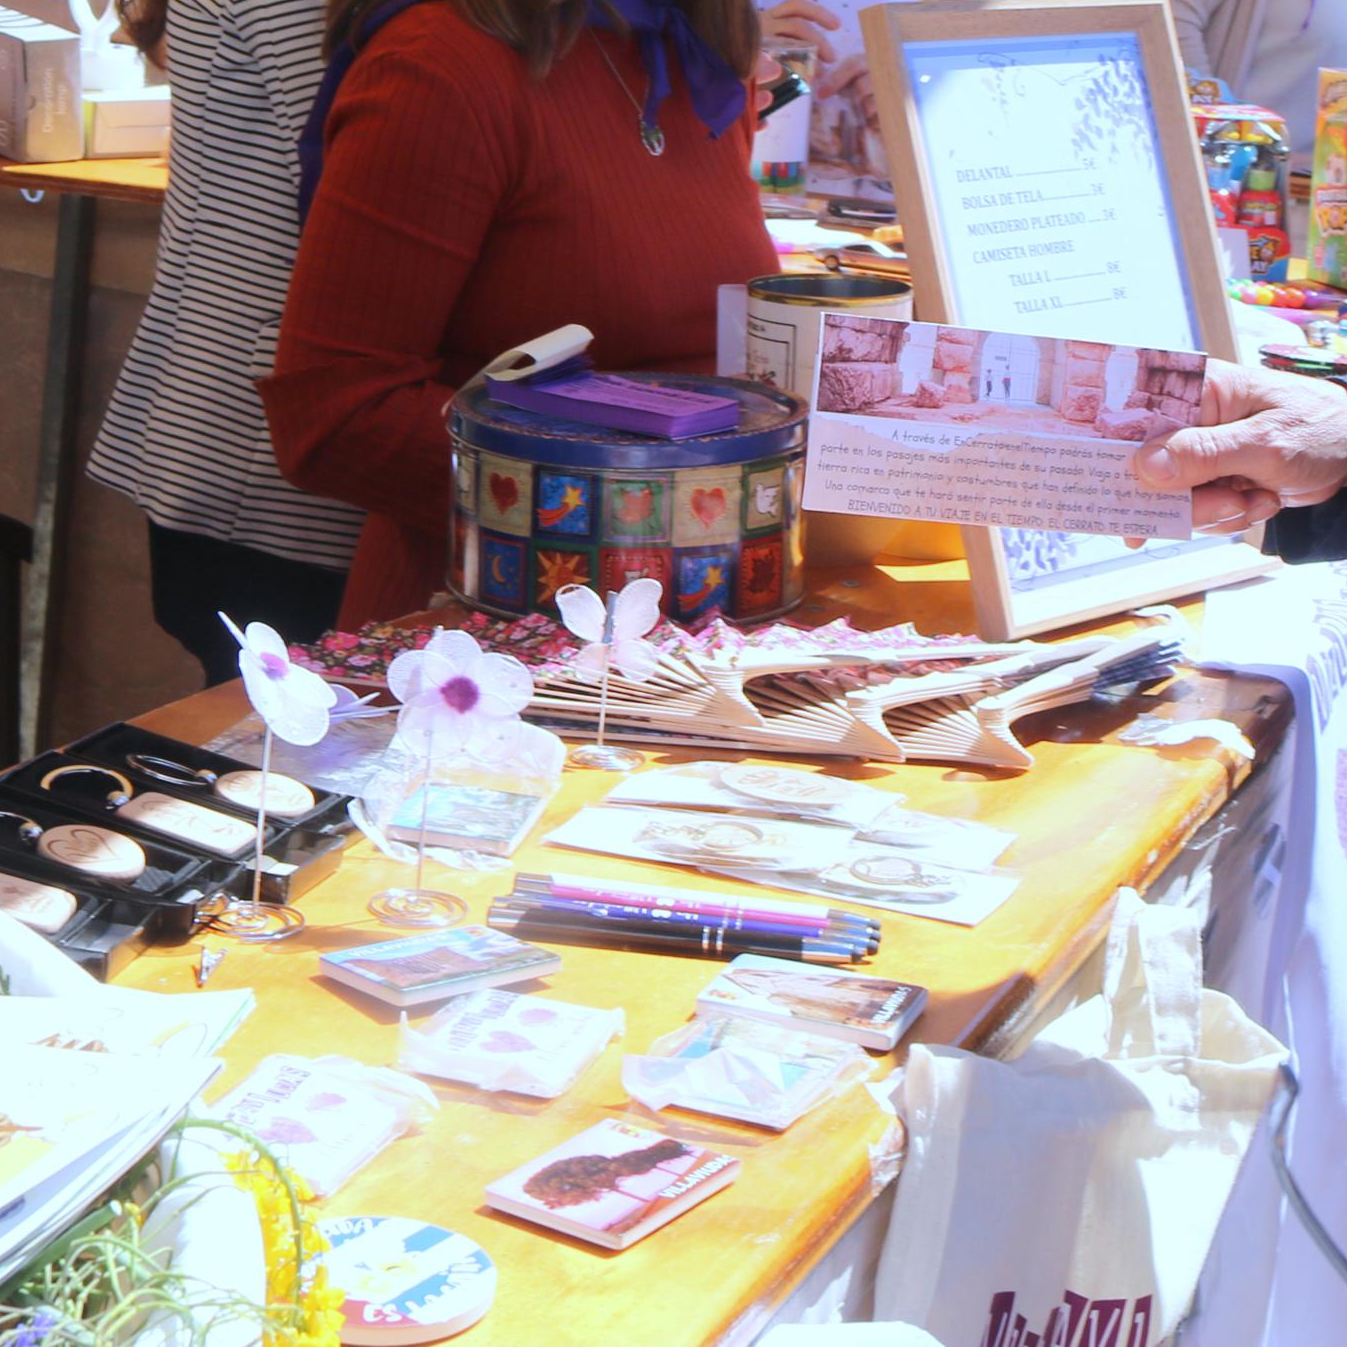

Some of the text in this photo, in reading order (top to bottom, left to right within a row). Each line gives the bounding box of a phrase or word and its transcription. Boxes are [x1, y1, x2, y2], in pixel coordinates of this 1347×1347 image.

[956, 166, 1013, 183] DELANTAL
[962, 194, 998, 210] BOLSA
[1000, 193, 1014, 206] DE
[1015, 190, 1043, 204] TELA
[967, 218, 1030, 236] MONEDERO
[1031, 211, 1086, 230] PLATEADO
[973, 240, 1075, 264] CAMISETA HOMBRE
[1009, 272, 1042, 287] TALLA
[1014, 299, 1047, 314] TALLA
[892, 432, 899, 440] A
[903, 432, 936, 445] través
[939, 434, 951, 445] de
[820, 443, 850, 456] parte
[852, 445, 864, 456] en
[867, 445, 883, 458] los
[886, 448, 925, 465] pasajes
[929, 451, 951, 463] más
[954, 455, 1016, 470] importantes
[1019, 459, 1032, 471] de
[1034, 462, 1047, 472] su
[817, 460, 848, 473] tierra
[851, 462, 871, 475] rica
[873, 466, 885, 477] en
[888, 466, 945, 482] patrimonio
[956, 472, 1019, 490] costumbres
[1021, 480, 1040, 494] que
[1114, 488, 1132, 503] que
[1135, 488, 1153, 503] hoy
[825, 479, 844, 492] Una
[846, 483, 890, 496] comarca
[893, 486, 911, 500] que
[914, 487, 926, 499] te
[956, 492, 987, 504] sentir
[989, 495, 1018, 509] parte
[1020, 496, 1033, 508] de
[1054, 500, 1083, 513] desde
[1086, 502, 1096, 513] el
[1097, 504, 1131, 518] primer
[847, 499, 911, 516] BIENVENIDO
[915, 504, 922, 517] A
[925, 506, 938, 518] TU
[940, 507, 971, 520] VIAJE
[974, 510, 988, 522] EN
[991, 512, 1003, 523] EL
[1048, 517, 1060, 529] EL
[1063, 518, 1106, 532] CERRATO
[1108, 522, 1120, 533] TE
